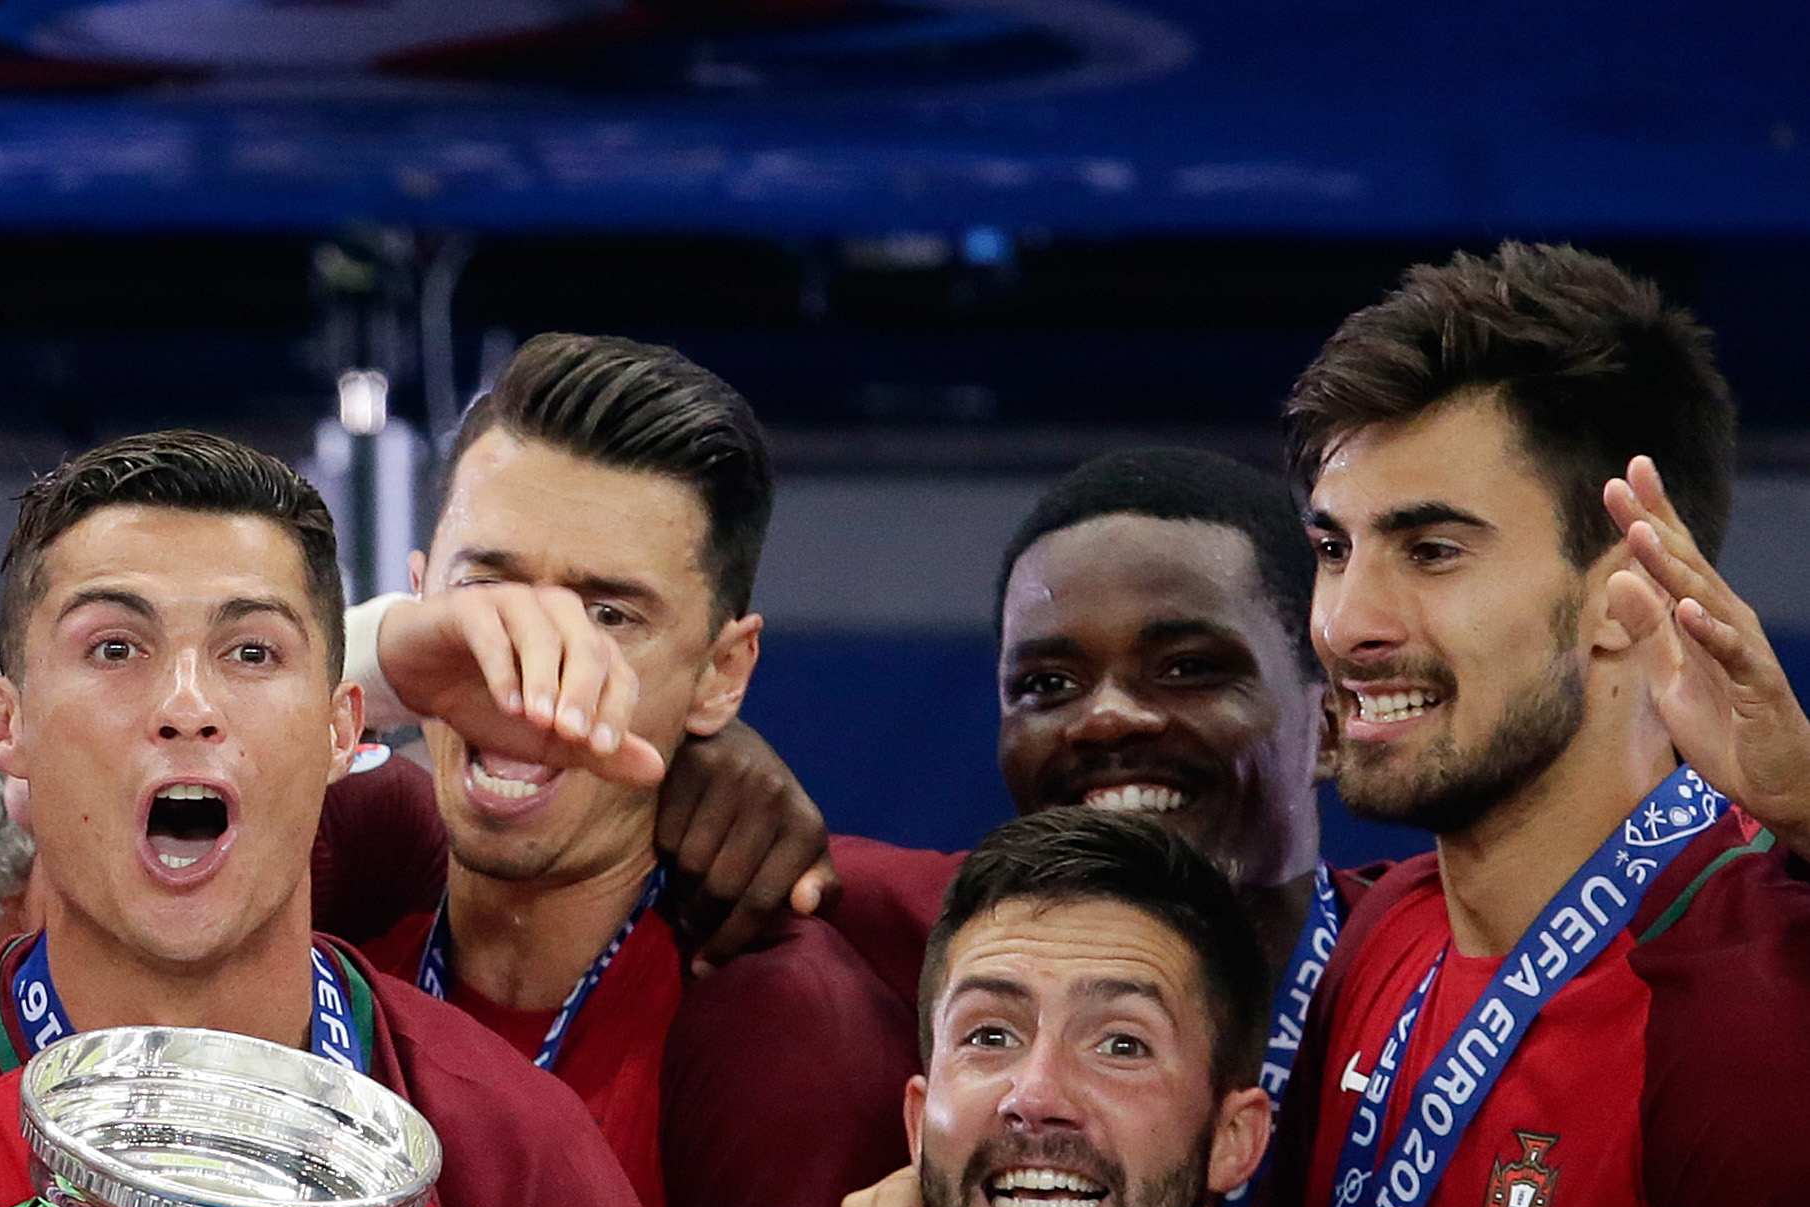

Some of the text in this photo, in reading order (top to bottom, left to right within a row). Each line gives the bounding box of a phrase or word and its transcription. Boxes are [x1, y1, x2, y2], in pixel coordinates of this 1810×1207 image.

[1504, 874, 1627, 998] UEFA
[1352, 1007, 1418, 1147] UEFA
[1421, 998, 1516, 1137] EURO
